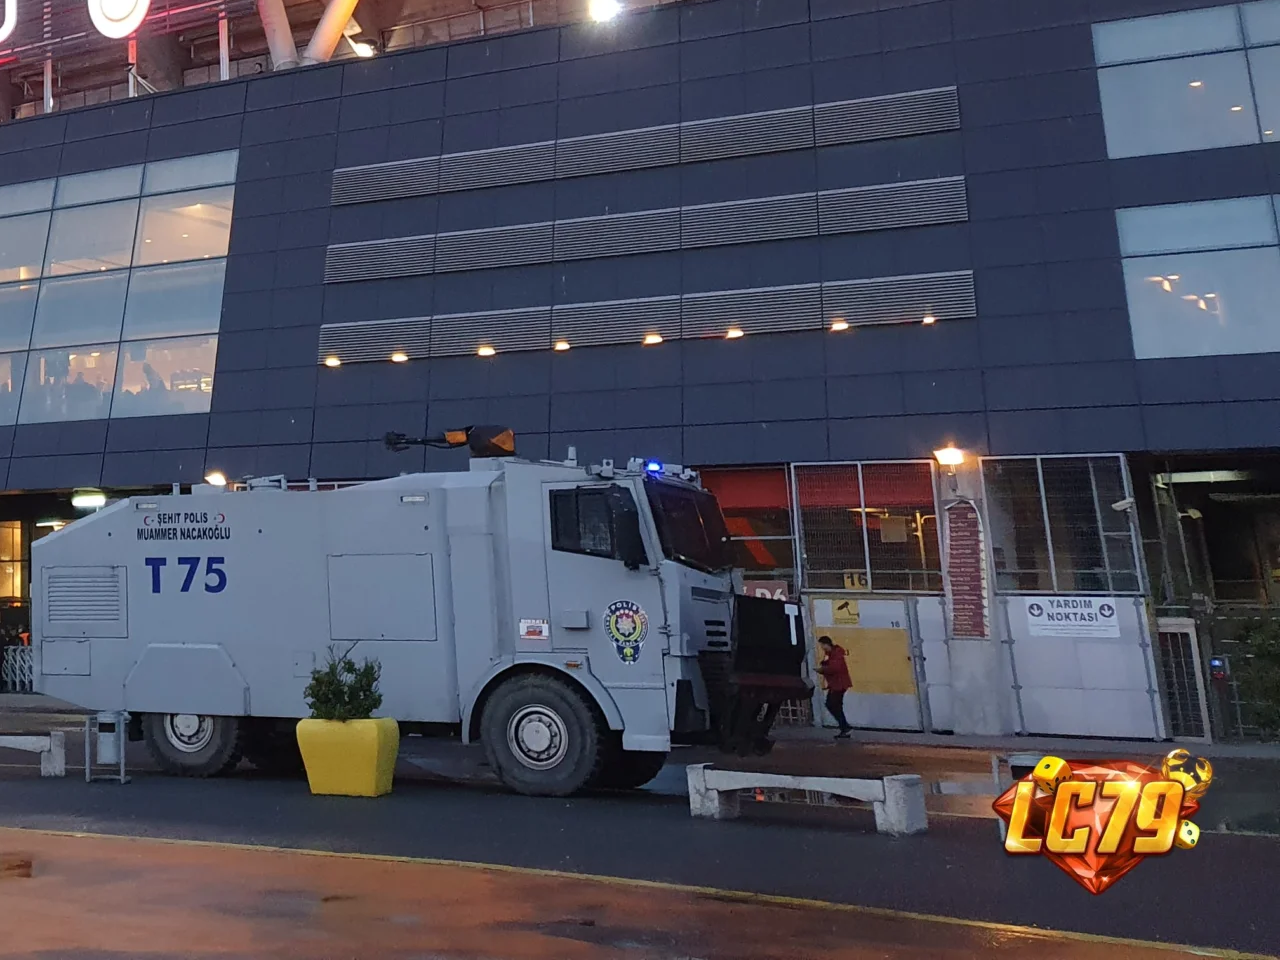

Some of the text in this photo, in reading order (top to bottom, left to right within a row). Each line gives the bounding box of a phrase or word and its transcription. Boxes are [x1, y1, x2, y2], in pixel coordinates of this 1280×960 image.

[137, 527, 178, 541] MUAMMER
[145, 556, 228, 593] T 75
[1048, 599, 1093, 609] YARDIM
[1047, 612, 1099, 622] NOKTASI
